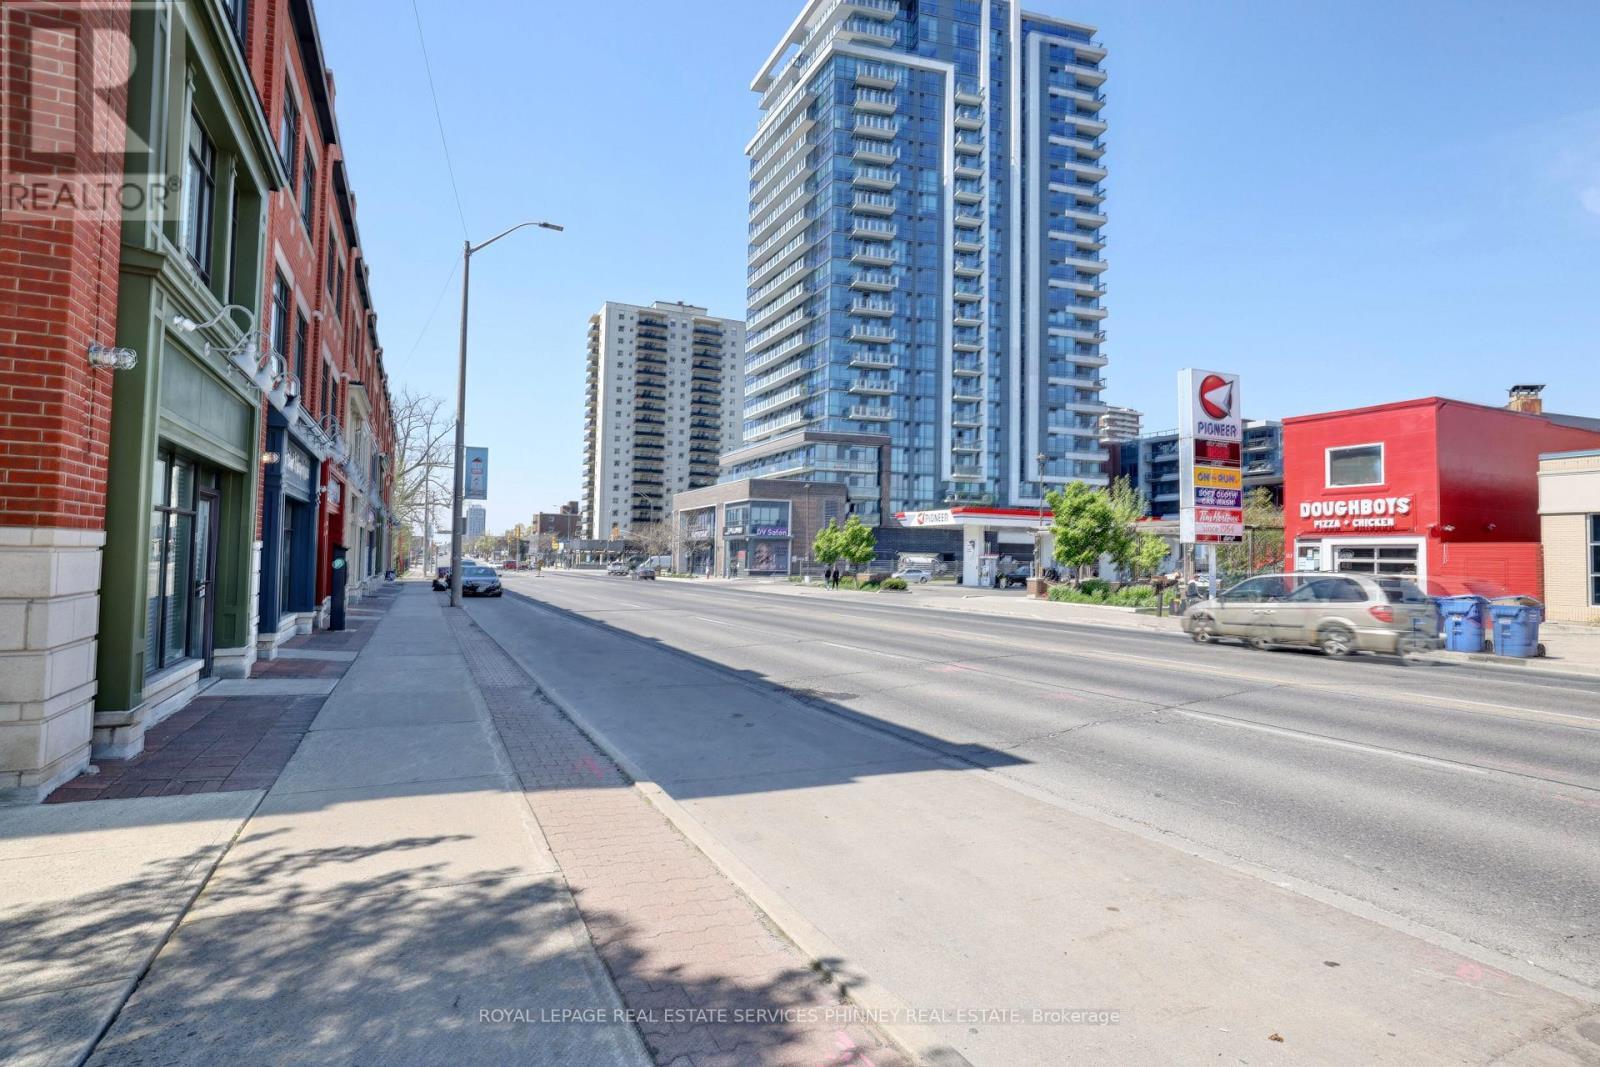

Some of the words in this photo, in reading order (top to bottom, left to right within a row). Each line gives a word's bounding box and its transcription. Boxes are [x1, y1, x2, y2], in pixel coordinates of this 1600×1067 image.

[1197, 421, 1237, 437] PIONEER
[1300, 496, 1412, 518] DOUGHBOYS
[924, 512, 949, 523] PIONEER
[1313, 519, 1341, 529] PIZZA
[1352, 517, 1395, 528] CHICKEN
[767, 527, 788, 537] Salon
